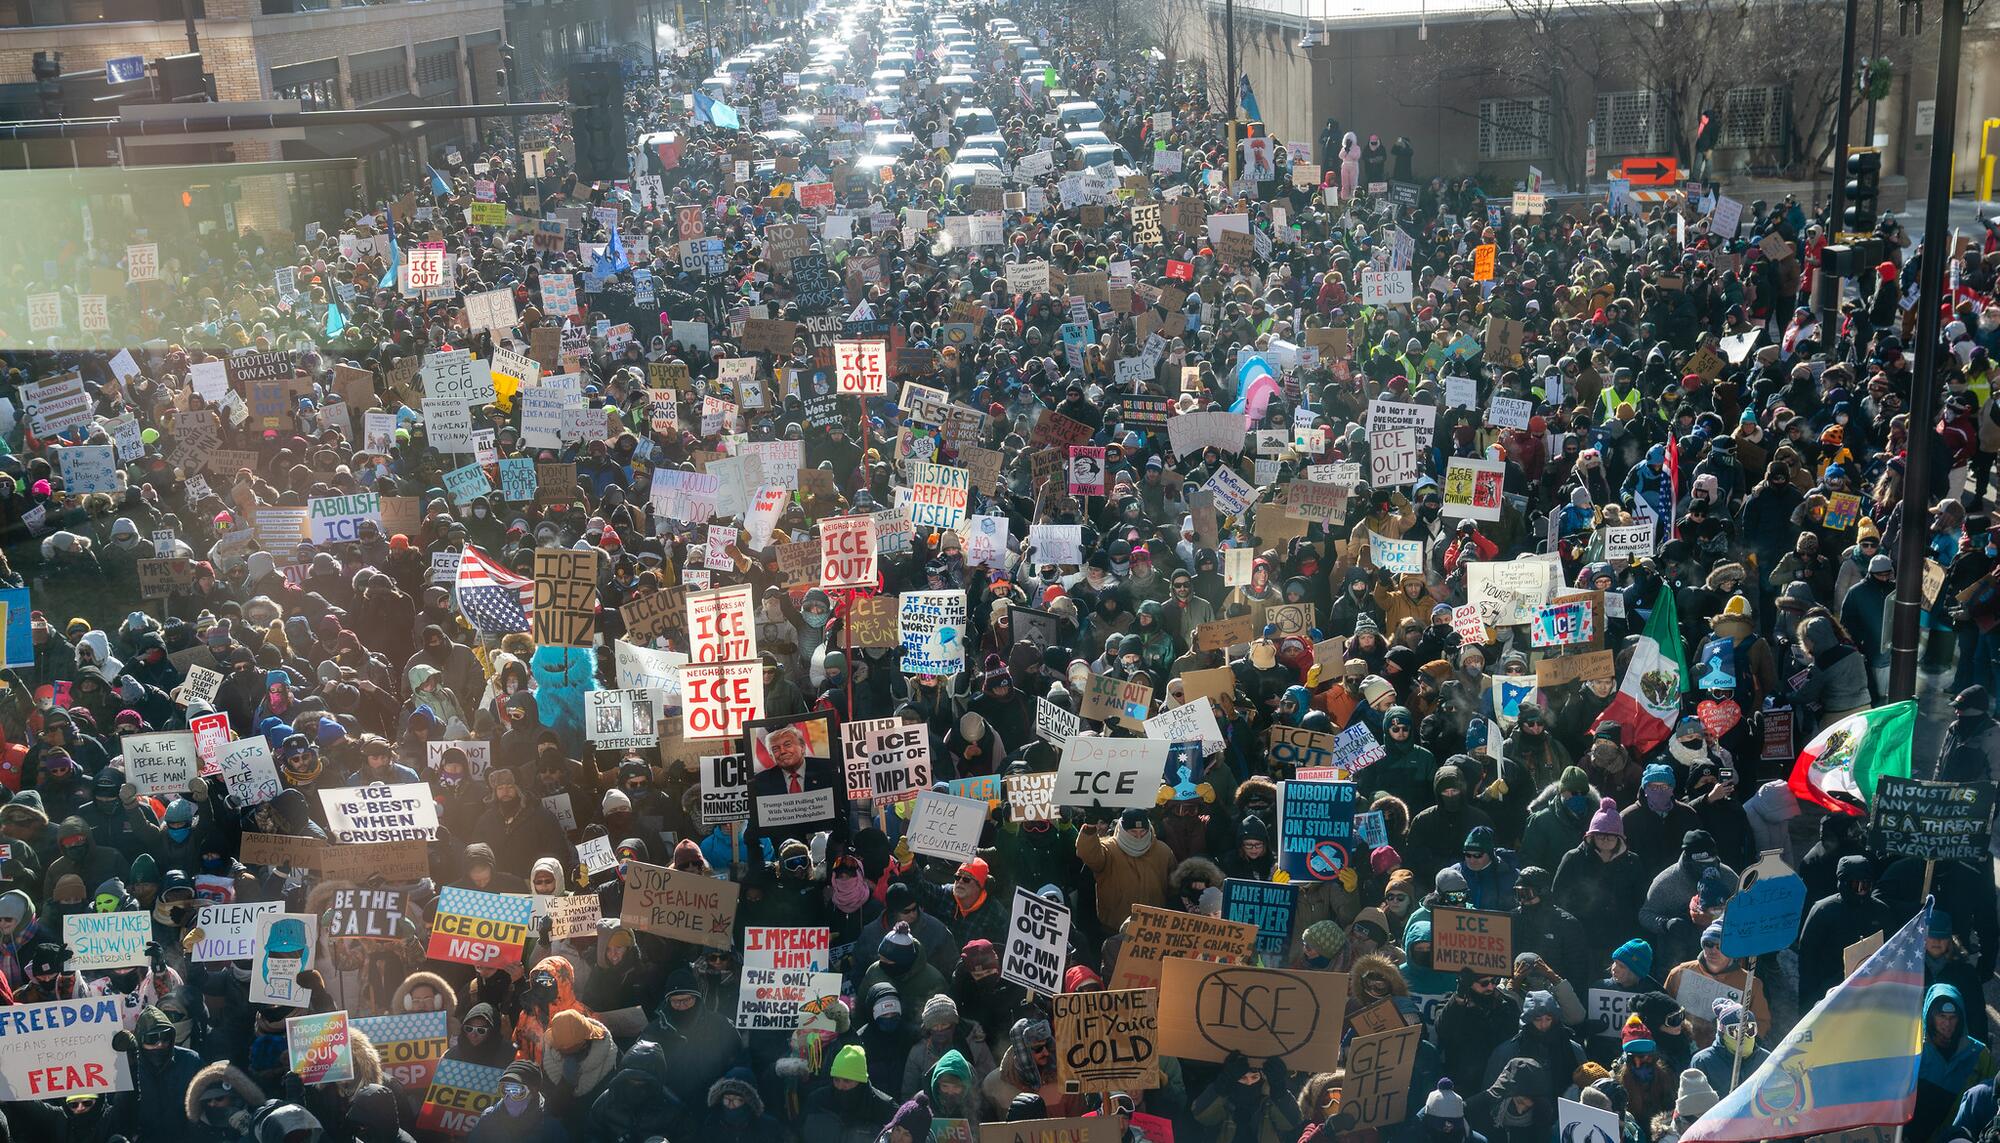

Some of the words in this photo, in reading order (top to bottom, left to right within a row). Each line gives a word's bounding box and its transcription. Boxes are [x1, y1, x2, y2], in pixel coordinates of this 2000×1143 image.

[1135, 207, 1159, 221] ICE
[1136, 219, 1161, 232] OUT
[1136, 231, 1161, 242] NOW
[131, 254, 154, 265] ICE
[412, 260, 436, 271] ICE
[131, 266, 156, 277] OUT!
[412, 273, 439, 285] OUT!
[1366, 272, 1398, 282] MICRO
[1368, 282, 1404, 297] PENIS
[83, 304, 104, 315] ICE
[83, 317, 106, 328] OUT!
[807, 316, 843, 335] RIGHTS
[435, 363, 471, 379] ICE
[651, 364, 686, 378] DEPORT
[842, 354, 879, 372] ICE
[844, 374, 882, 392] OUT!
[26, 385, 68, 399] INVADING
[655, 392, 670, 400] NO
[1492, 407, 1528, 418] JONATHAN
[1496, 400, 1526, 409] ARREST
[33, 412, 93, 434] EVERYWHERE
[1498, 417, 1518, 426] ROSS
[1372, 432, 1407, 450] ICE
[1073, 448, 1102, 456] SASHAY
[1373, 452, 1414, 473] OUT
[915, 463, 968, 488] HISTORY
[1378, 474, 1392, 484] OF
[1400, 470, 1418, 481] MN
[914, 485, 966, 505] REPEATS
[1077, 486, 1096, 494] AWAY
[312, 493, 379, 519] ABOLISH
[913, 505, 961, 528] ITSELF
[324, 520, 366, 541] ICE
[1609, 533, 1626, 544] ICE
[1629, 532, 1650, 543] OUT
[825, 531, 868, 556] ICE
[1371, 537, 1417, 552] JUSTICE
[536, 554, 593, 581] ICE
[706, 558, 732, 568] FAMILY
[825, 558, 872, 581] OUT!
[536, 580, 594, 611] DEEZ
[903, 604, 941, 615] AFTER
[945, 607, 965, 615] THE
[1455, 606, 1476, 618] GOD
[697, 611, 745, 640] ICE
[901, 622, 934, 632] WORST
[902, 613, 938, 624] WORST
[1454, 616, 1480, 627] KNOWS
[536, 610, 595, 647] NUTZ
[904, 633, 931, 644] WHY
[699, 639, 750, 664] OUT!
[190, 673, 219, 684] CLEARLY
[200, 669, 215, 677] YOU
[686, 667, 735, 678] NEIGHBORS
[737, 664, 753, 674] SAY
[192, 679, 213, 688] SLEPT
[192, 685, 210, 694] THRU
[688, 679, 750, 704] ICE
[594, 690, 622, 704] SPOT
[627, 689, 647, 701] THE
[690, 705, 756, 731] OUT!
[1039, 702, 1076, 728] HUMAN
[598, 737, 651, 748] DIFFERENCE
[877, 733, 921, 750] ICE
[1276, 728, 1322, 748] ICE
[133, 743, 151, 753] WE
[156, 741, 176, 750] THE
[1070, 740, 1149, 767] Deport
[872, 750, 908, 765] OUT
[911, 747, 927, 761] OF
[1272, 747, 1329, 766] OUT
[136, 774, 157, 784] THE
[163, 769, 186, 782] MAN!
[875, 765, 928, 794] MPLS
[1070, 771, 1138, 794] ICE
[1298, 771, 1334, 779] ORGANIZE
[360, 786, 393, 799] ICE
[1288, 784, 1336, 801] NOBODY
[1340, 787, 1353, 802] IS
[1886, 783, 1976, 802] INJUSTICE
[341, 802, 358, 815] IS
[367, 800, 415, 813] BEST
[926, 801, 957, 817] Hold
[1012, 805, 1061, 821] LOVE
[1286, 802, 1331, 819] ILLEGAL
[352, 814, 414, 828] WHEN
[926, 822, 957, 836] ICE
[1285, 821, 1301, 836] ON
[1305, 821, 1349, 838] STOLEN
[1922, 820, 1984, 834] THREAT
[340, 828, 435, 844] CRUSHED!
[1284, 836, 1315, 853] LAND
[1911, 832, 1970, 845] JUSTICE
[630, 864, 672, 891] STOP
[336, 888, 354, 910] BE
[358, 889, 399, 911] THE
[640, 890, 719, 910] STEALING
[1231, 884, 1260, 902] HATE
[1264, 888, 1290, 906] WILL
[651, 906, 704, 932] PEOPLE
[1024, 901, 1058, 923] ICE
[1229, 903, 1288, 932] NEVER
[67, 915, 150, 936] SNOWFLAKES
[331, 911, 402, 937] SALT
[433, 913, 472, 936] ICE
[476, 920, 525, 944] OUT
[1017, 916, 1062, 945] OUT
[1456, 915, 1488, 933] ICE
[1135, 928, 1161, 943] FOR
[1165, 933, 1200, 949] THESE
[1439, 933, 1504, 951] MURDERS
[448, 939, 501, 962] MSP
[1013, 940, 1032, 955] OF
[1034, 946, 1059, 970] MN
[1130, 944, 1157, 960] ARE
[1435, 950, 1506, 970] AMERICANS
[747, 970, 775, 984] THE
[782, 973, 814, 987] ONLY
[1007, 960, 1058, 988] NOW
[742, 1001, 799, 1016] MONARCH
[1053, 997, 1084, 1020] GO
[1087, 990, 1146, 1012] HOME
[1207, 982, 1296, 1035] ICE
[0, 1000, 119, 1037] FREEDOM
[739, 1014, 748, 1028] I
[753, 1014, 799, 1028] ADMIRE
[1076, 1018, 1098, 1040] IF
[1, 1038, 47, 1053] MEANS
[54, 1033, 107, 1049] FREEDOM
[36, 1050, 77, 1062] FROM
[1066, 1036, 1154, 1069] COLD
[1353, 1034, 1414, 1074] GET
[28, 1063, 108, 1095] FEAR
[1342, 1093, 1401, 1126] OUT
